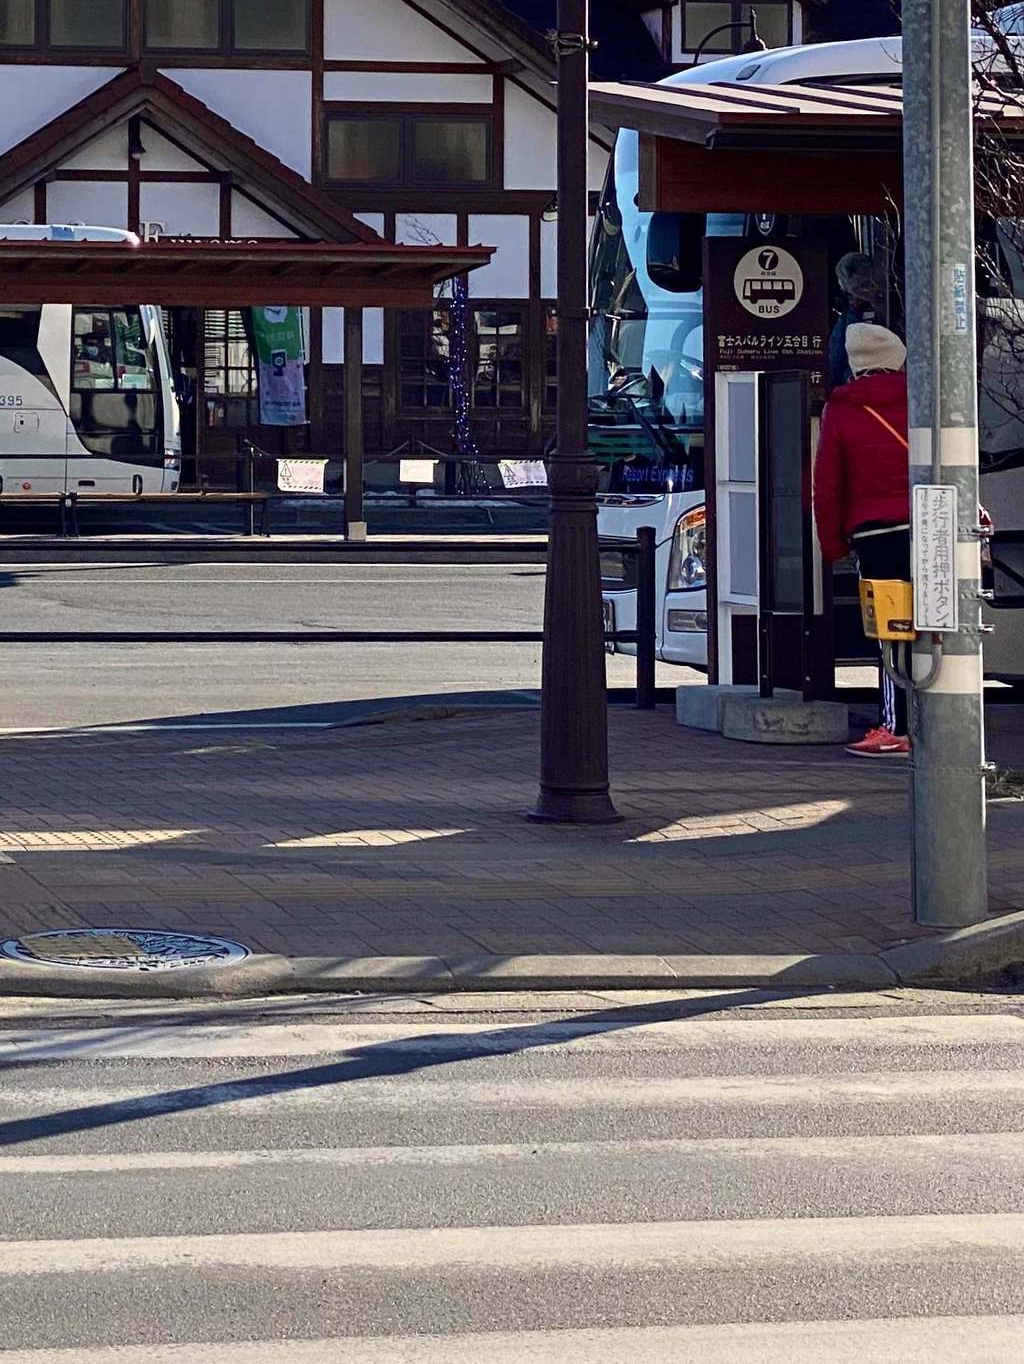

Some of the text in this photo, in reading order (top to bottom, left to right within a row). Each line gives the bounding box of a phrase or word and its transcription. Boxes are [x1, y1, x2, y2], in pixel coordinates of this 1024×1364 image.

[762, 251, 774, 269] 7
[758, 305, 780, 314] BUS
[717, 335, 822, 348] 富士スバルライン五合目 行
[810, 371, 823, 384] 行
[932, 491, 951, 623] 歩行者用押ボタン
